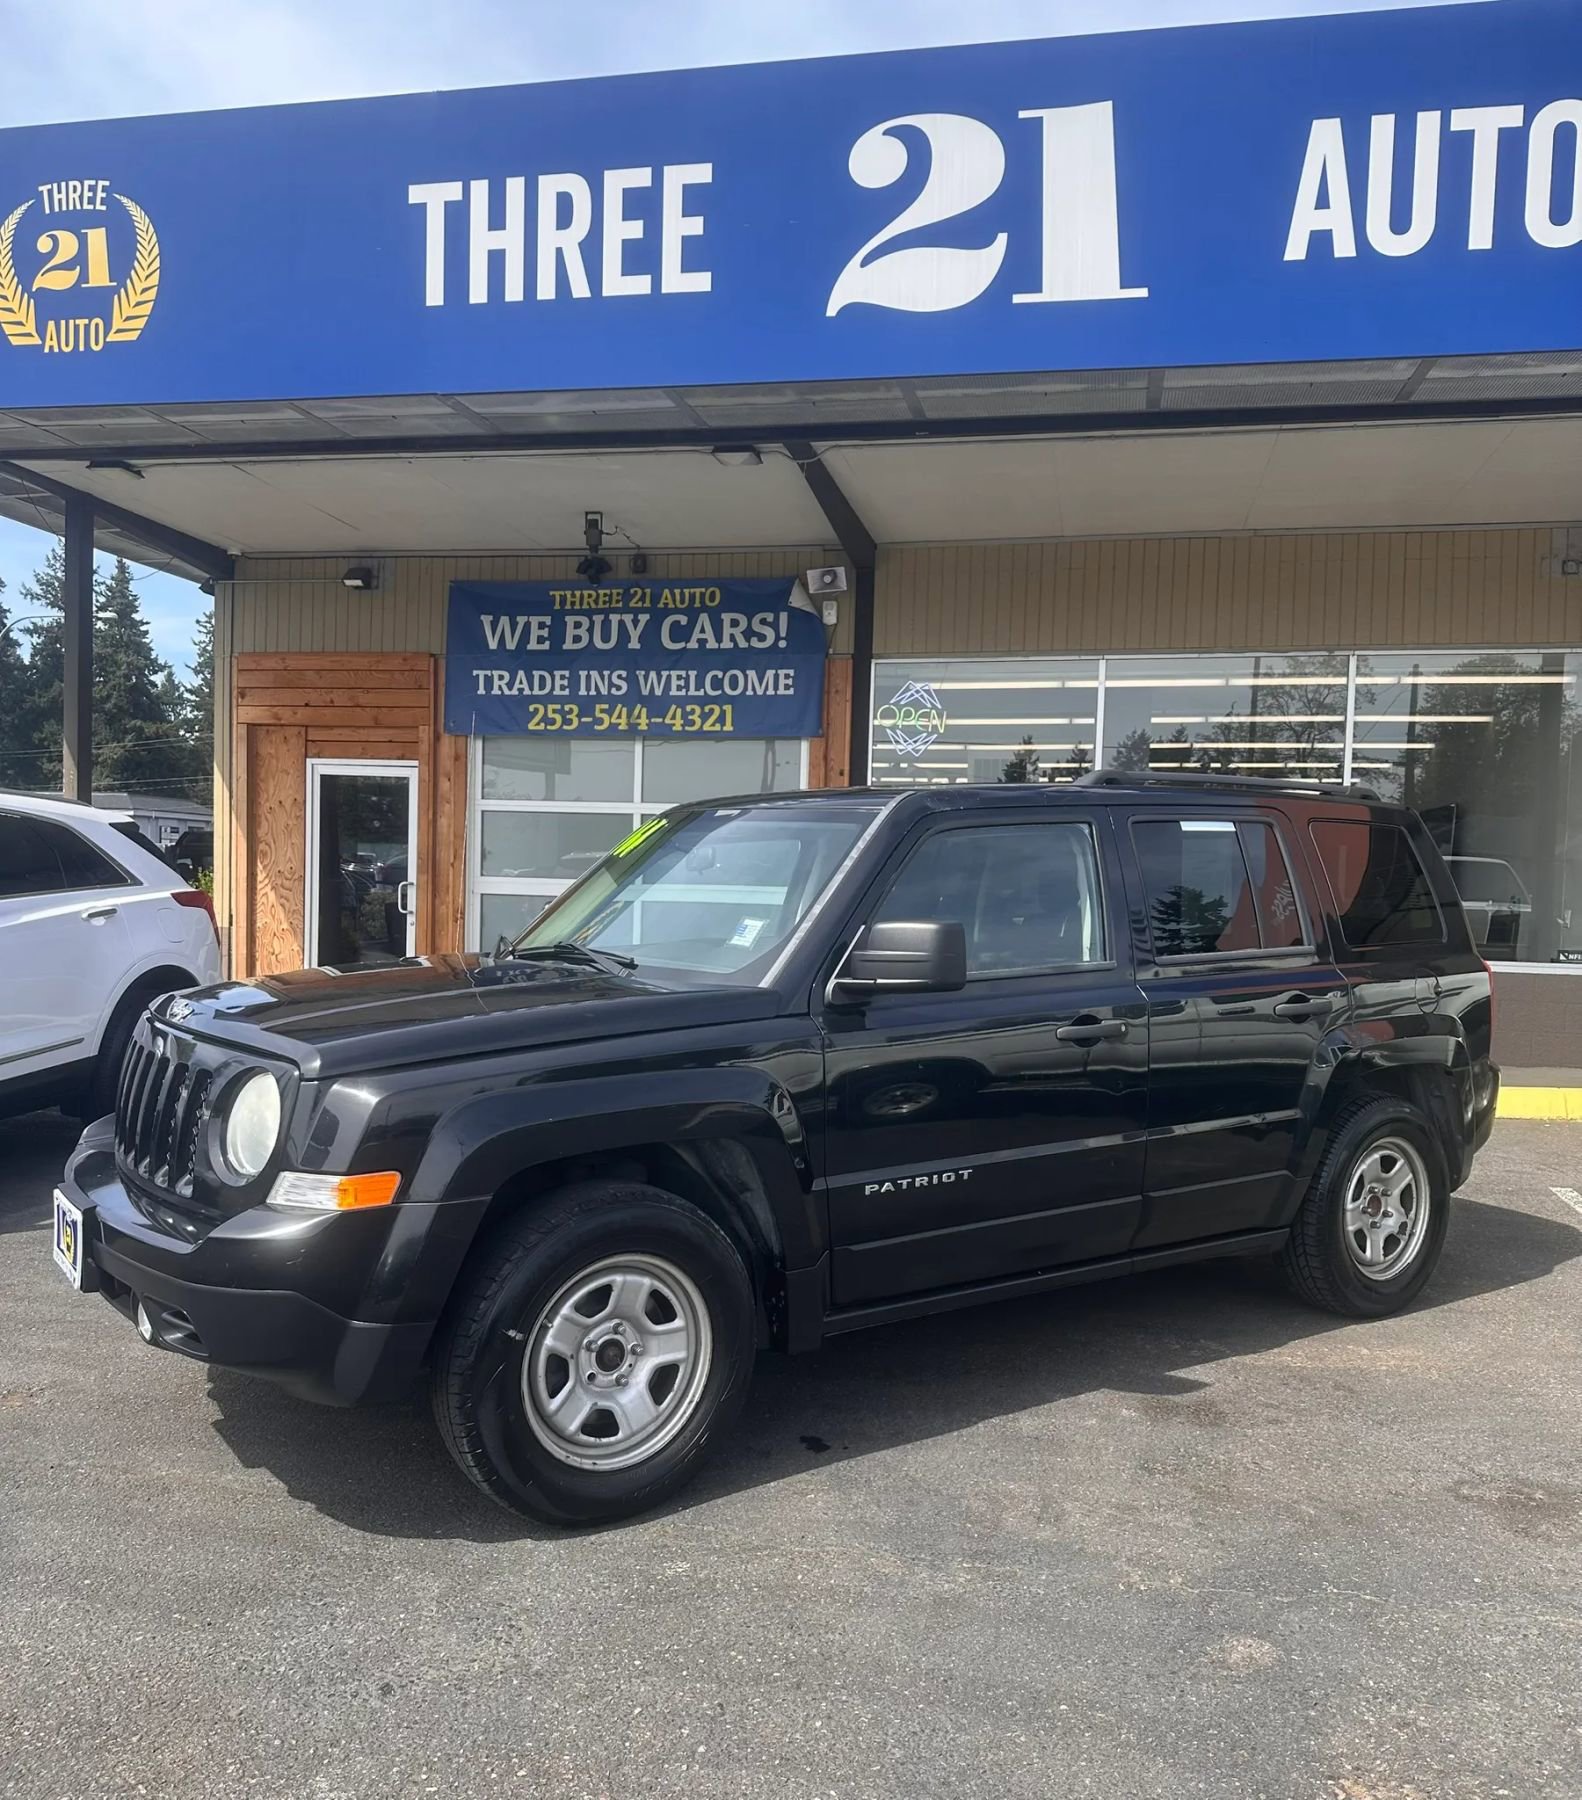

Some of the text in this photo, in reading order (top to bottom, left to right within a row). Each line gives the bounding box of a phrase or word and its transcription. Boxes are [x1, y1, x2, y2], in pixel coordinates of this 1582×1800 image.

[38, 180, 110, 214] THREE
[408, 99, 1582, 317] THREE 21 AUTO
[32, 227, 117, 292] 21
[44, 317, 105, 353] AUTO
[550, 587, 721, 610] THREE 21 AUTO
[480, 611, 789, 650] WE BUY CARS!
[472, 669, 795, 696] TRADE INS WELCOME
[527, 703, 734, 731] 253-544-4321
[877, 704, 947, 734] OPEN
[864, 1169, 973, 1196] PATRIOT
